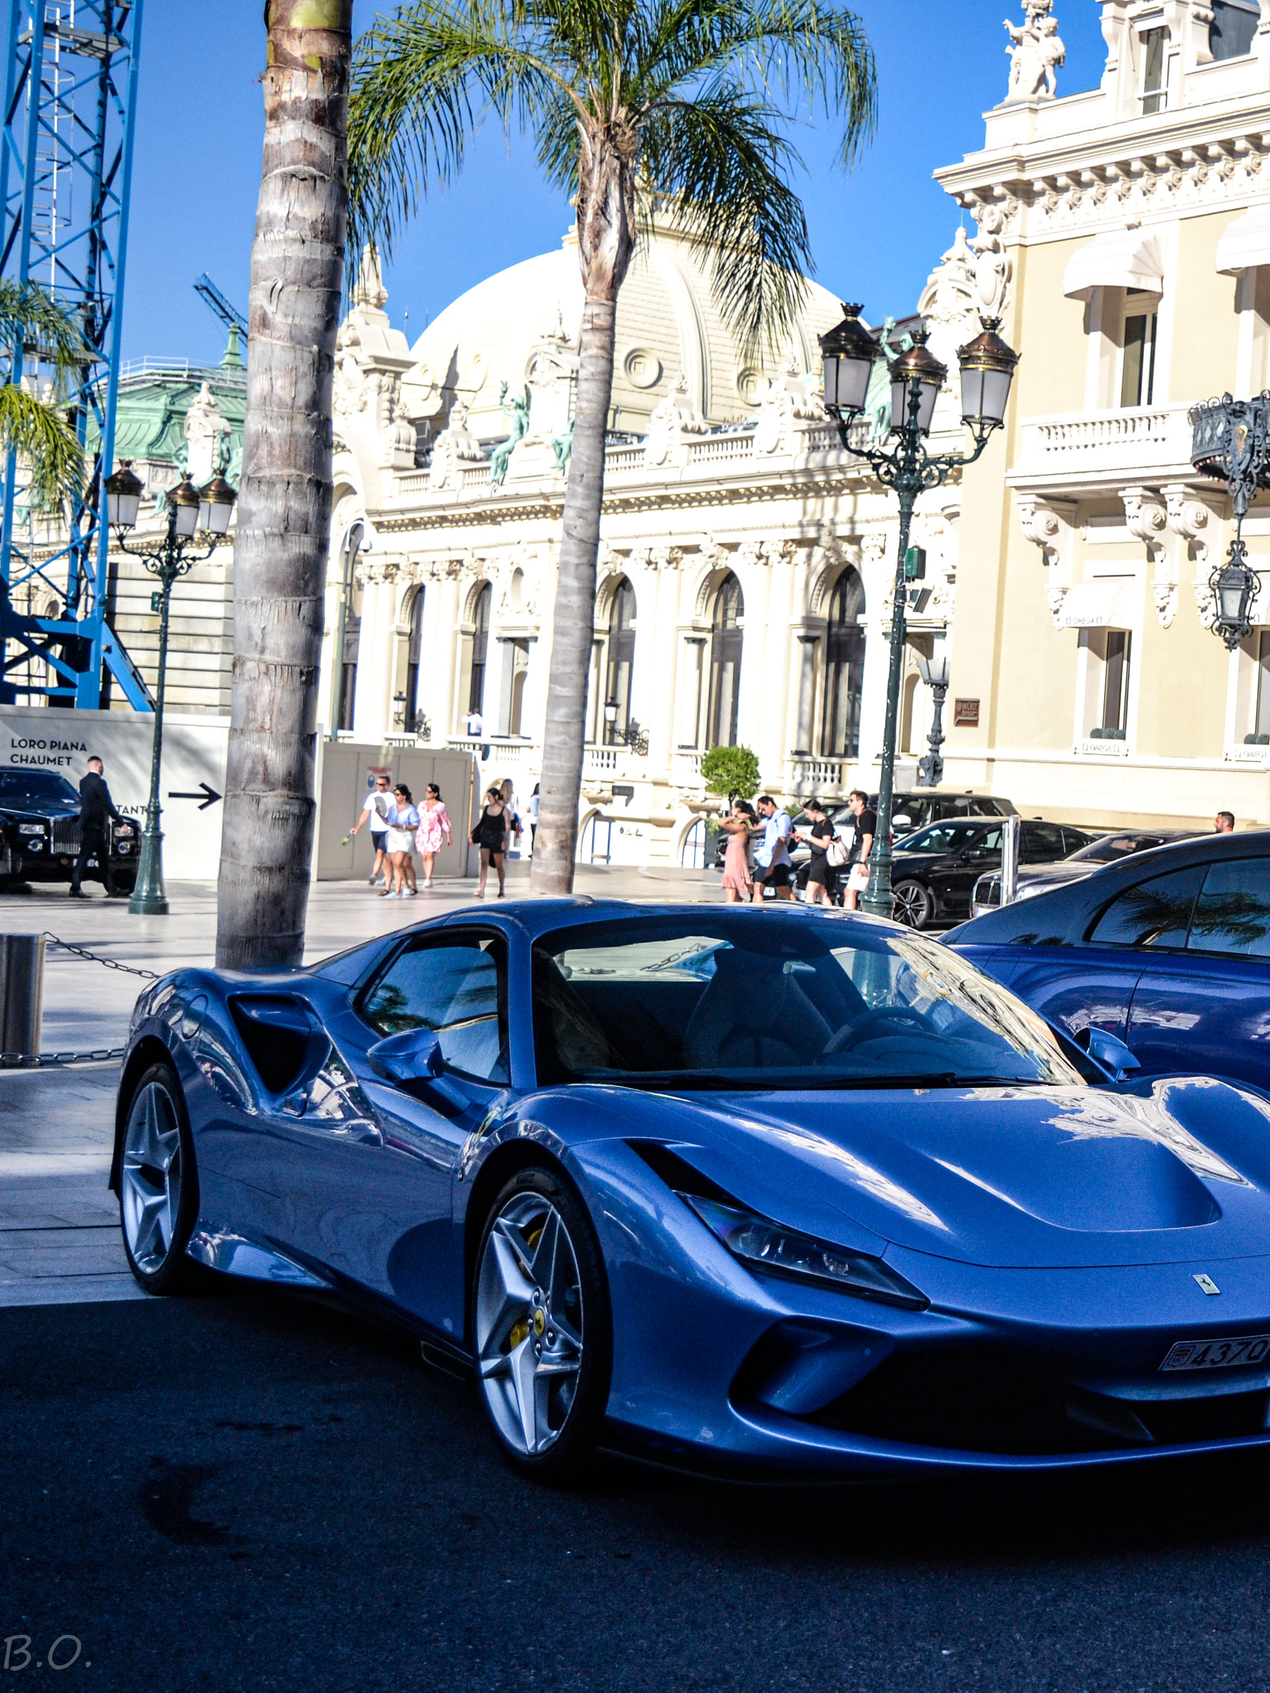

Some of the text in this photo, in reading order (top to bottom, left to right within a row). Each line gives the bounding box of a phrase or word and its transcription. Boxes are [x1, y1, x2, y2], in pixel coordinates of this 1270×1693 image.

[11, 738, 88, 751] LORO PIANA
[10, 754, 73, 766] CHAUMET
